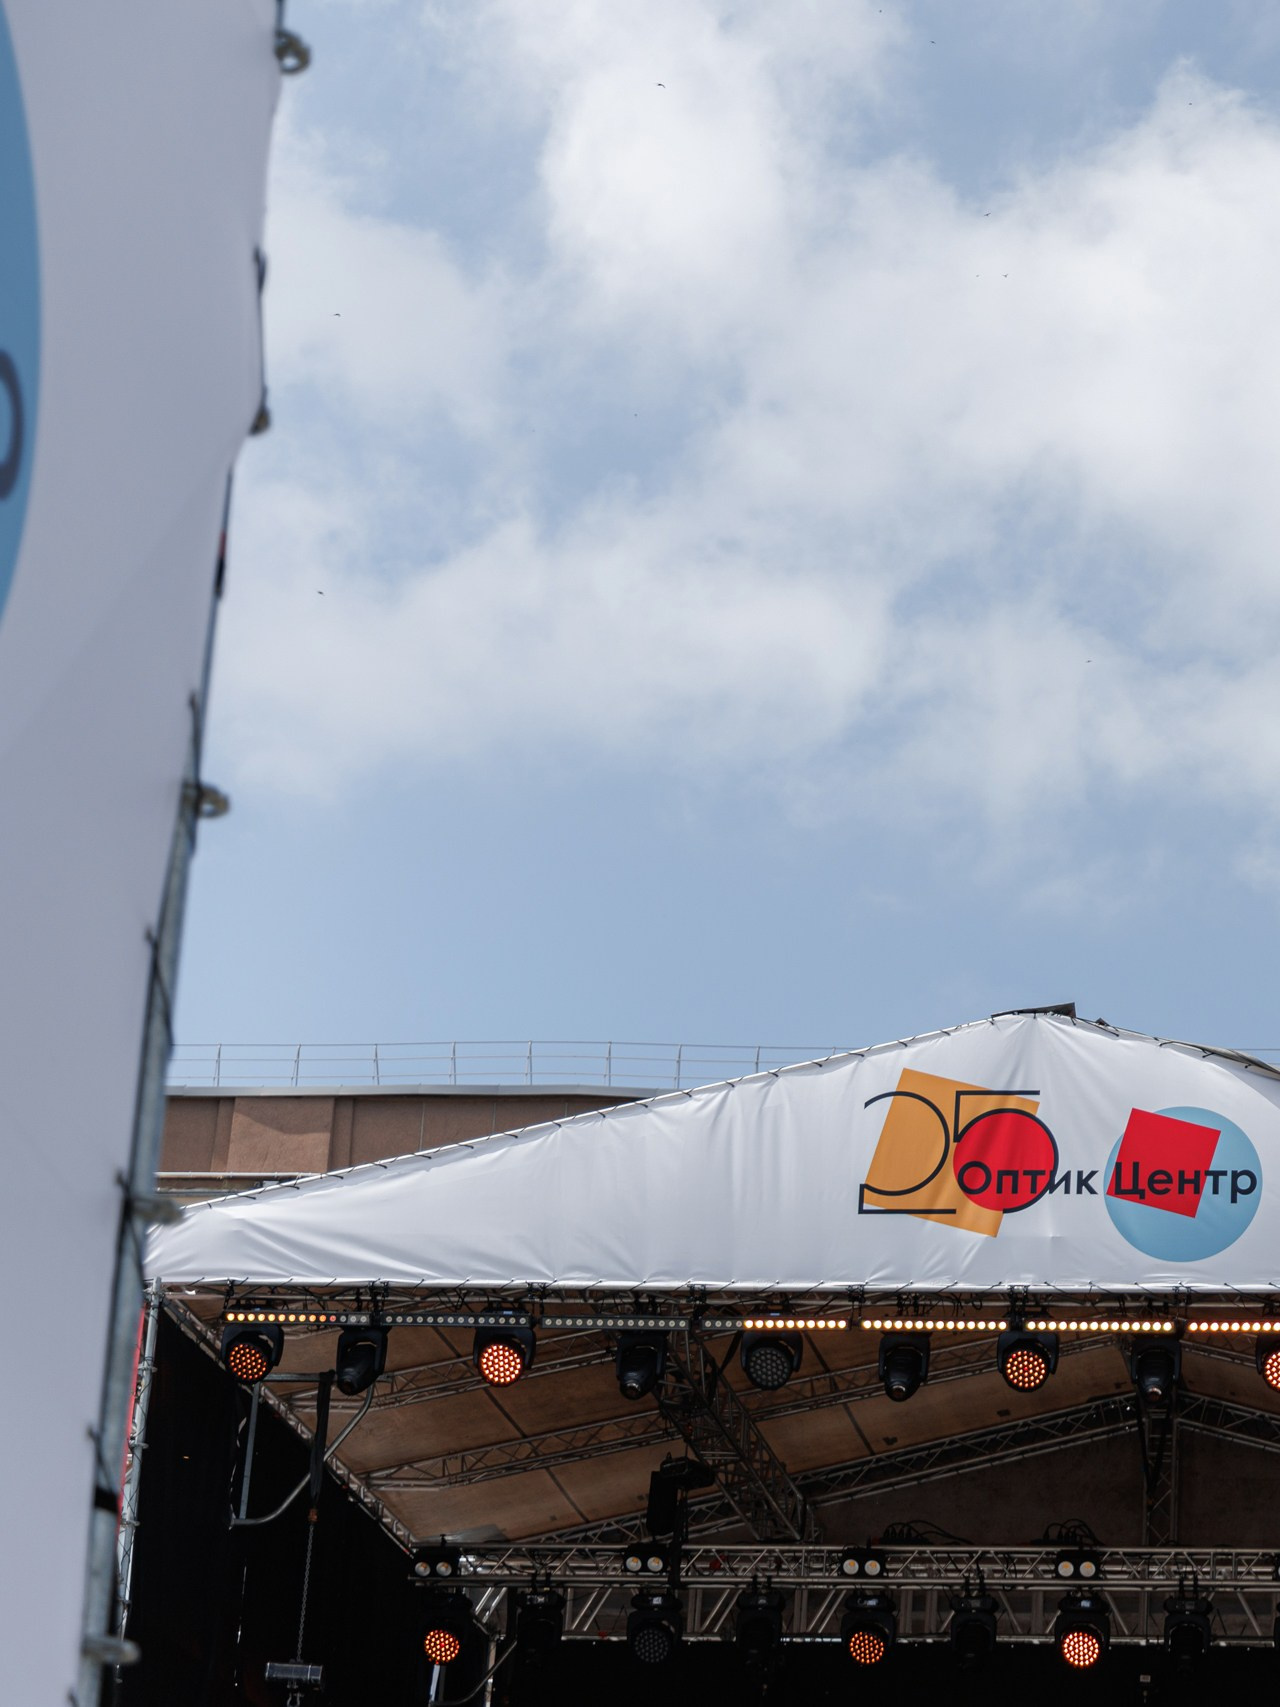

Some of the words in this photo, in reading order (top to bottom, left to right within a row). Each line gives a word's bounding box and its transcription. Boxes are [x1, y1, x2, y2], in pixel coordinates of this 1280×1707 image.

[858, 1090, 1059, 1214] 25
[957, 1160, 1099, 1195] Оптик
[1114, 1161, 1258, 1204] Центр
